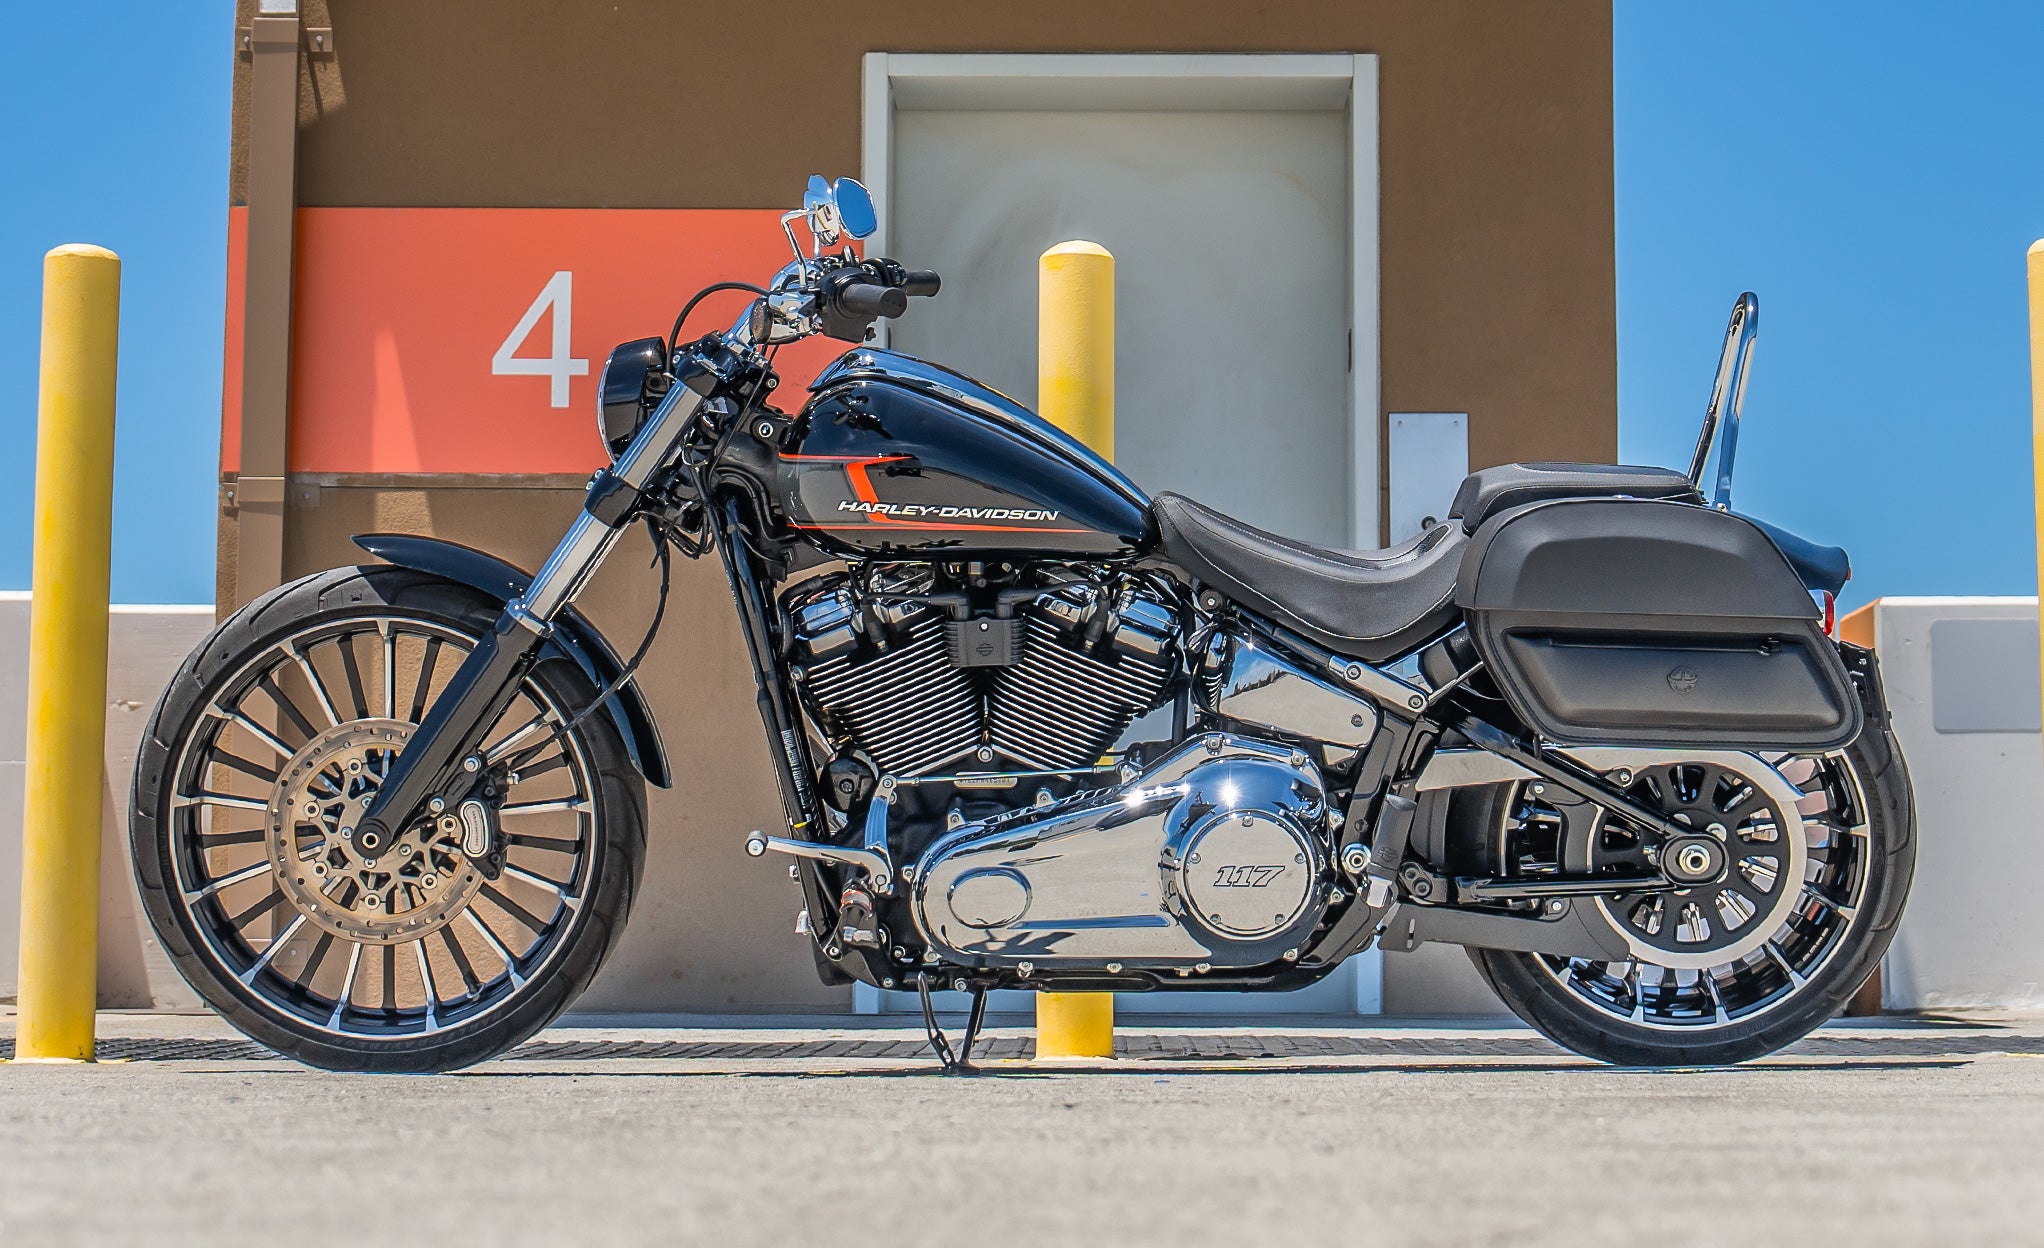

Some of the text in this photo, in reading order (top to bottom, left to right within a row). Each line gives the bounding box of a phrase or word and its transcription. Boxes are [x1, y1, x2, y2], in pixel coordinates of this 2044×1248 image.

[492, 271, 589, 408] 4
[838, 500, 1059, 521] HARLEY-DAVIDSON
[1213, 865, 1286, 887] 117
